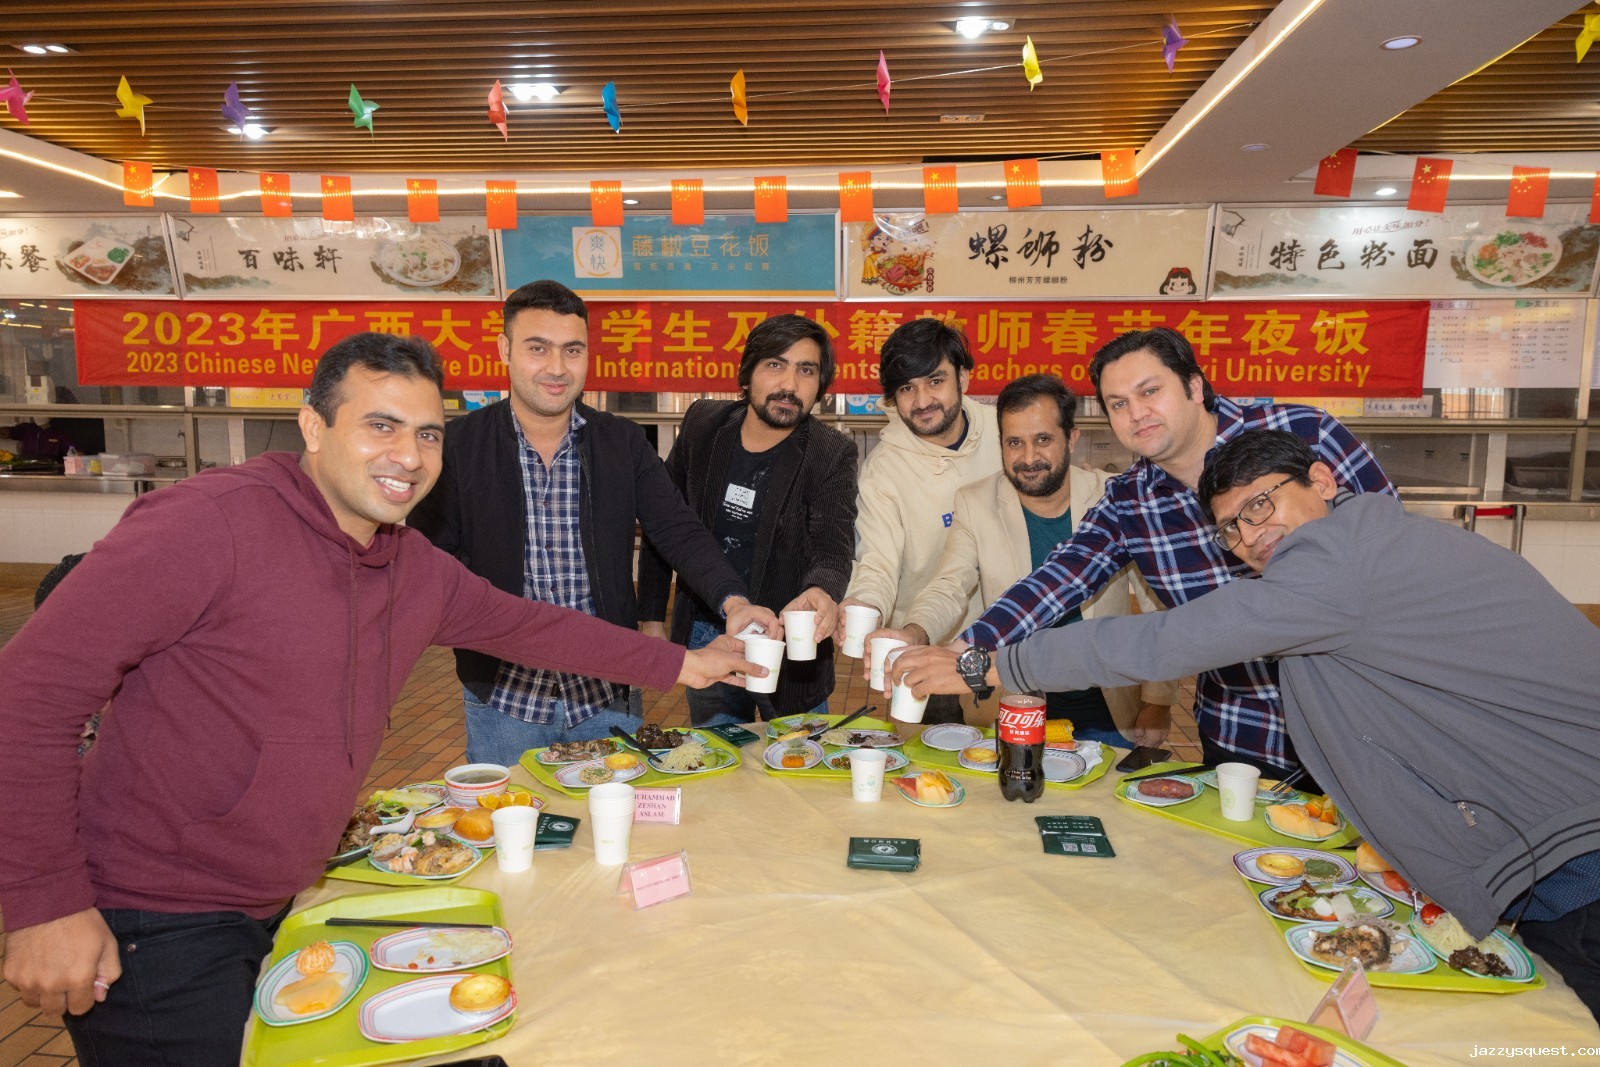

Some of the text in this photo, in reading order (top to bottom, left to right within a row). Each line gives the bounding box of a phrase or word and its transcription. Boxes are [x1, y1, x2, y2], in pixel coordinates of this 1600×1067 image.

[238, 245, 343, 274] 百味轩
[1269, 239, 1438, 271] 特色粉面
[127, 352, 178, 372] 2023
[184, 352, 276, 374] Chinese
[468, 354, 510, 377] Din
[595, 355, 738, 378] Internation
[1226, 358, 1370, 387] University
